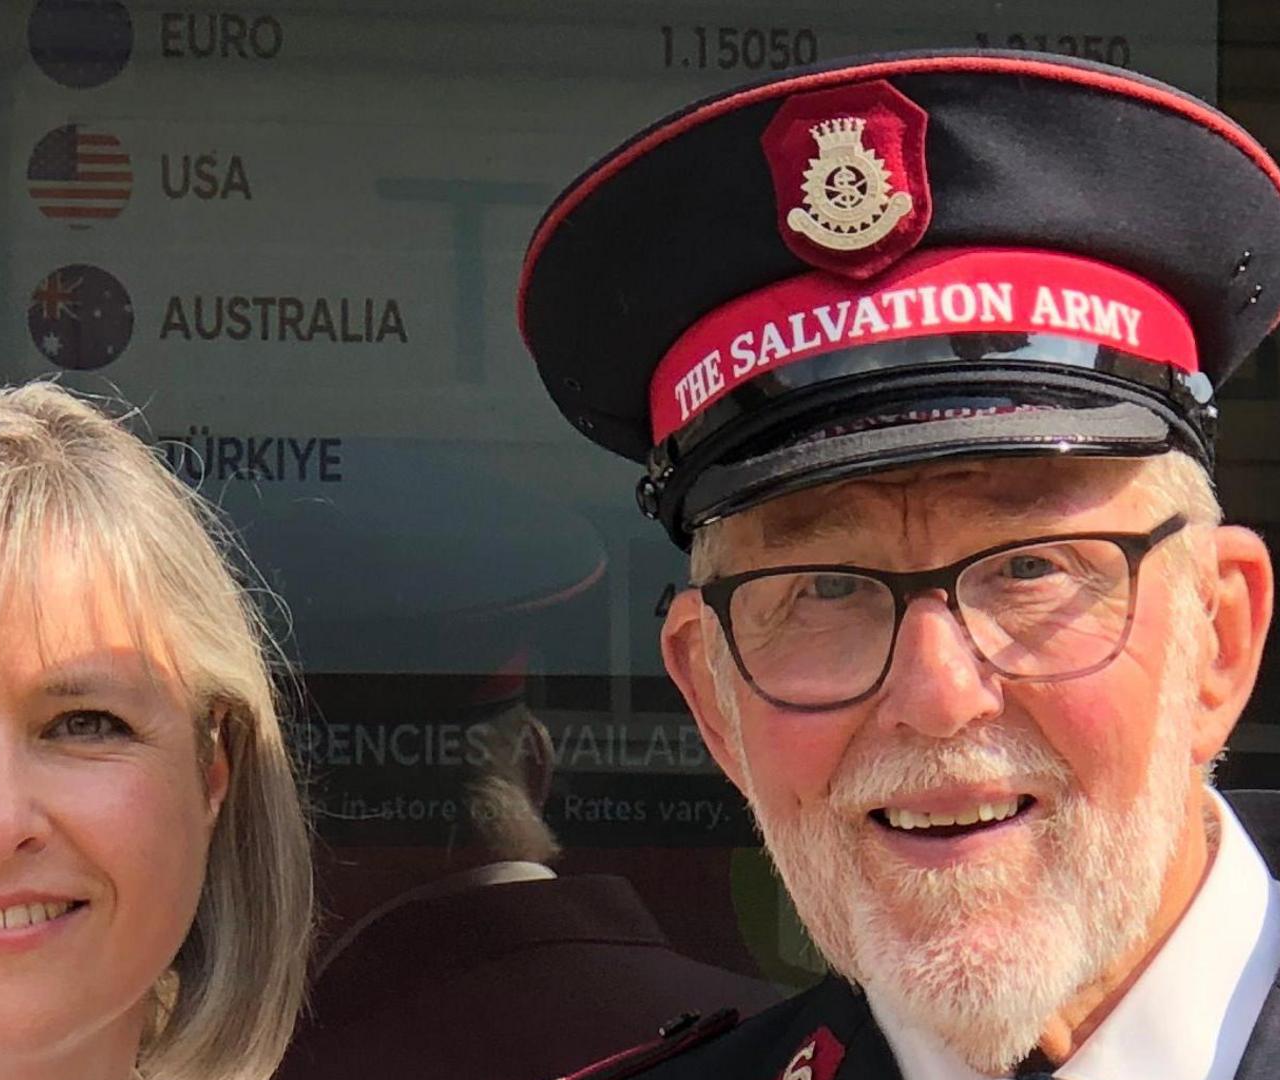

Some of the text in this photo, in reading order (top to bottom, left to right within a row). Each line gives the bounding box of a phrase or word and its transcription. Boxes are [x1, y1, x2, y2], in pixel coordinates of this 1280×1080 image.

[161, 13, 818, 70] EURO 1.15050
[160, 154, 252, 200] USA
[159, 297, 409, 344] AUSTRALIA
[674, 281, 1143, 422] THE SALVATION ARMY
[564, 795, 647, 822] Rates
[658, 798, 732, 833] vary.
